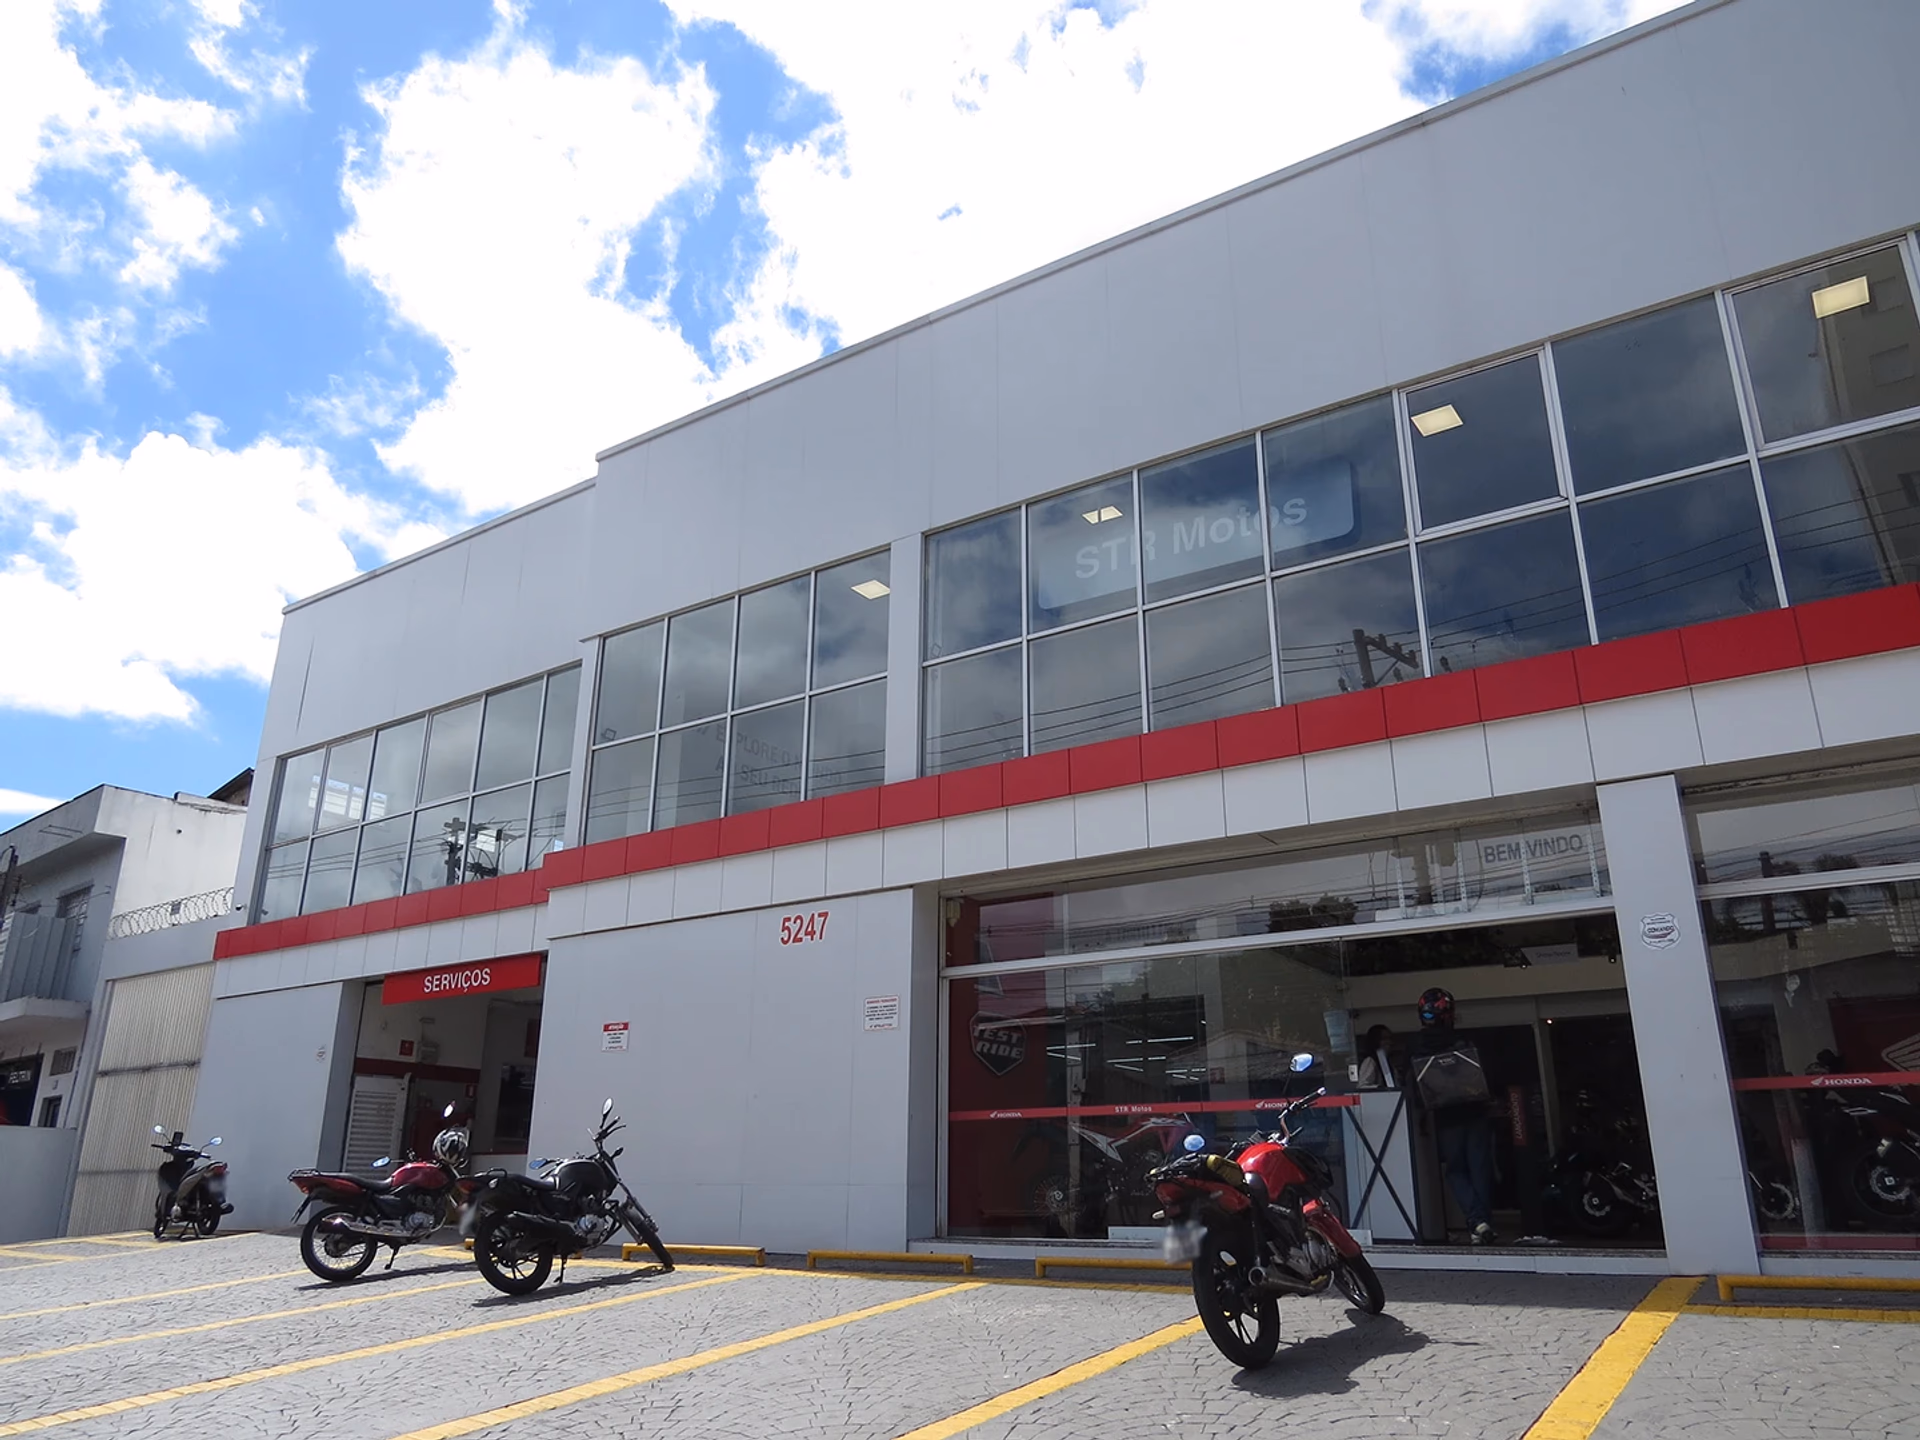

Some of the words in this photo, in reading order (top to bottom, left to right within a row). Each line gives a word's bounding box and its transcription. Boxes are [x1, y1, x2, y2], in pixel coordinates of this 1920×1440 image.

[1075, 530, 1156, 579] STR
[1173, 497, 1308, 554] Motos
[715, 723, 779, 765] EPLORE
[1484, 841, 1521, 863] BEM
[1525, 834, 1583, 857] VINDO
[780, 910, 830, 946] 5247
[423, 967, 491, 993] SERVIÇOS
[973, 1026, 1022, 1045] TEST
[976, 1041, 1023, 1059] RIDE
[1824, 1078, 1873, 1086] HONDA
[1115, 1105, 1129, 1113] STR
[1131, 1105, 1152, 1113] Motos
